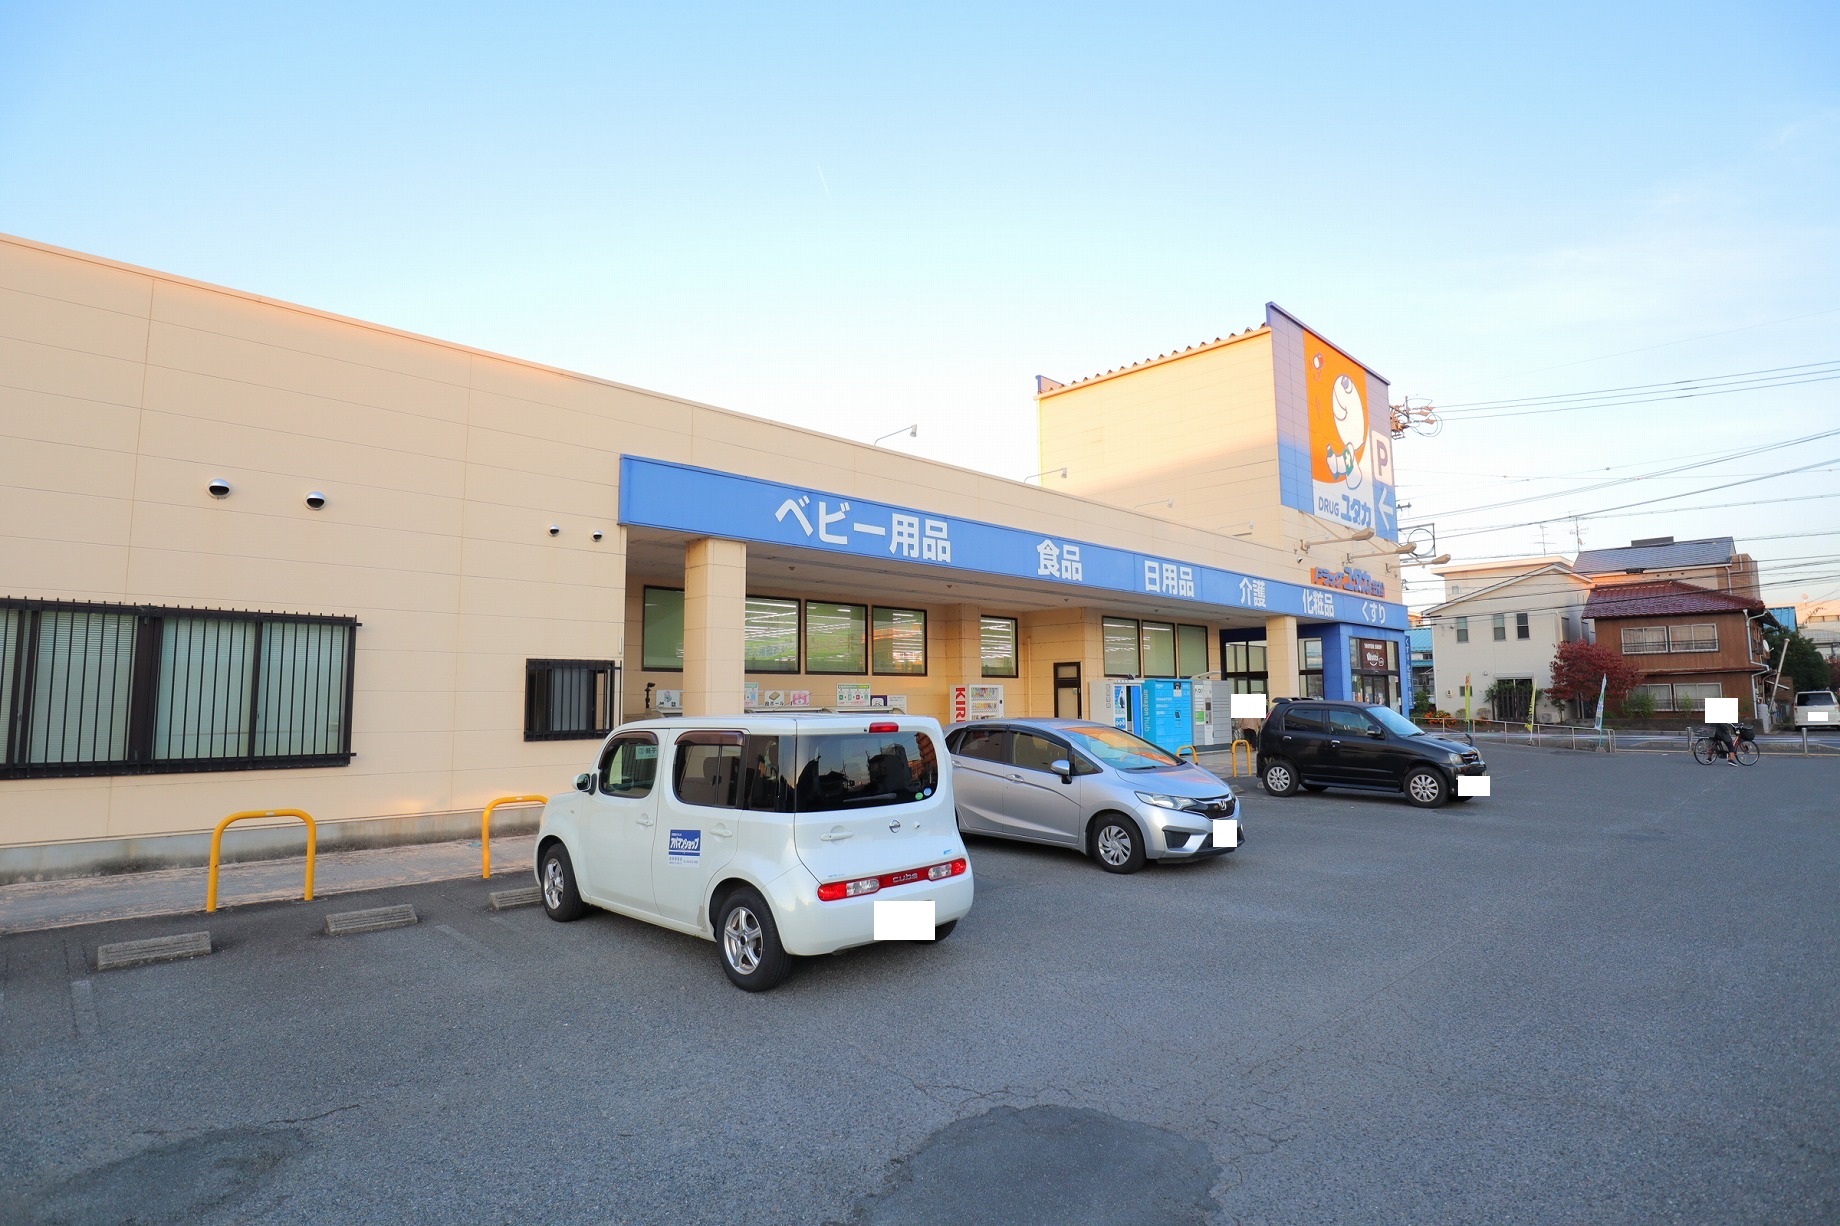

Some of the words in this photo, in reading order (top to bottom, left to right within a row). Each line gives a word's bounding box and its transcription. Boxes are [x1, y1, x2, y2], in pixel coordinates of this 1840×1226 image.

[1376, 438, 1389, 478] P
[1318, 496, 1339, 517] DRUG
[1341, 494, 1371, 528] ユタカ
[774, 495, 951, 563] ベビー用品
[1036, 539, 1083, 582] 食品
[1144, 560, 1195, 598] 日用品
[1239, 577, 1267, 608] 介護
[1302, 588, 1335, 618] 化粧品
[1361, 601, 1386, 624] くすり
